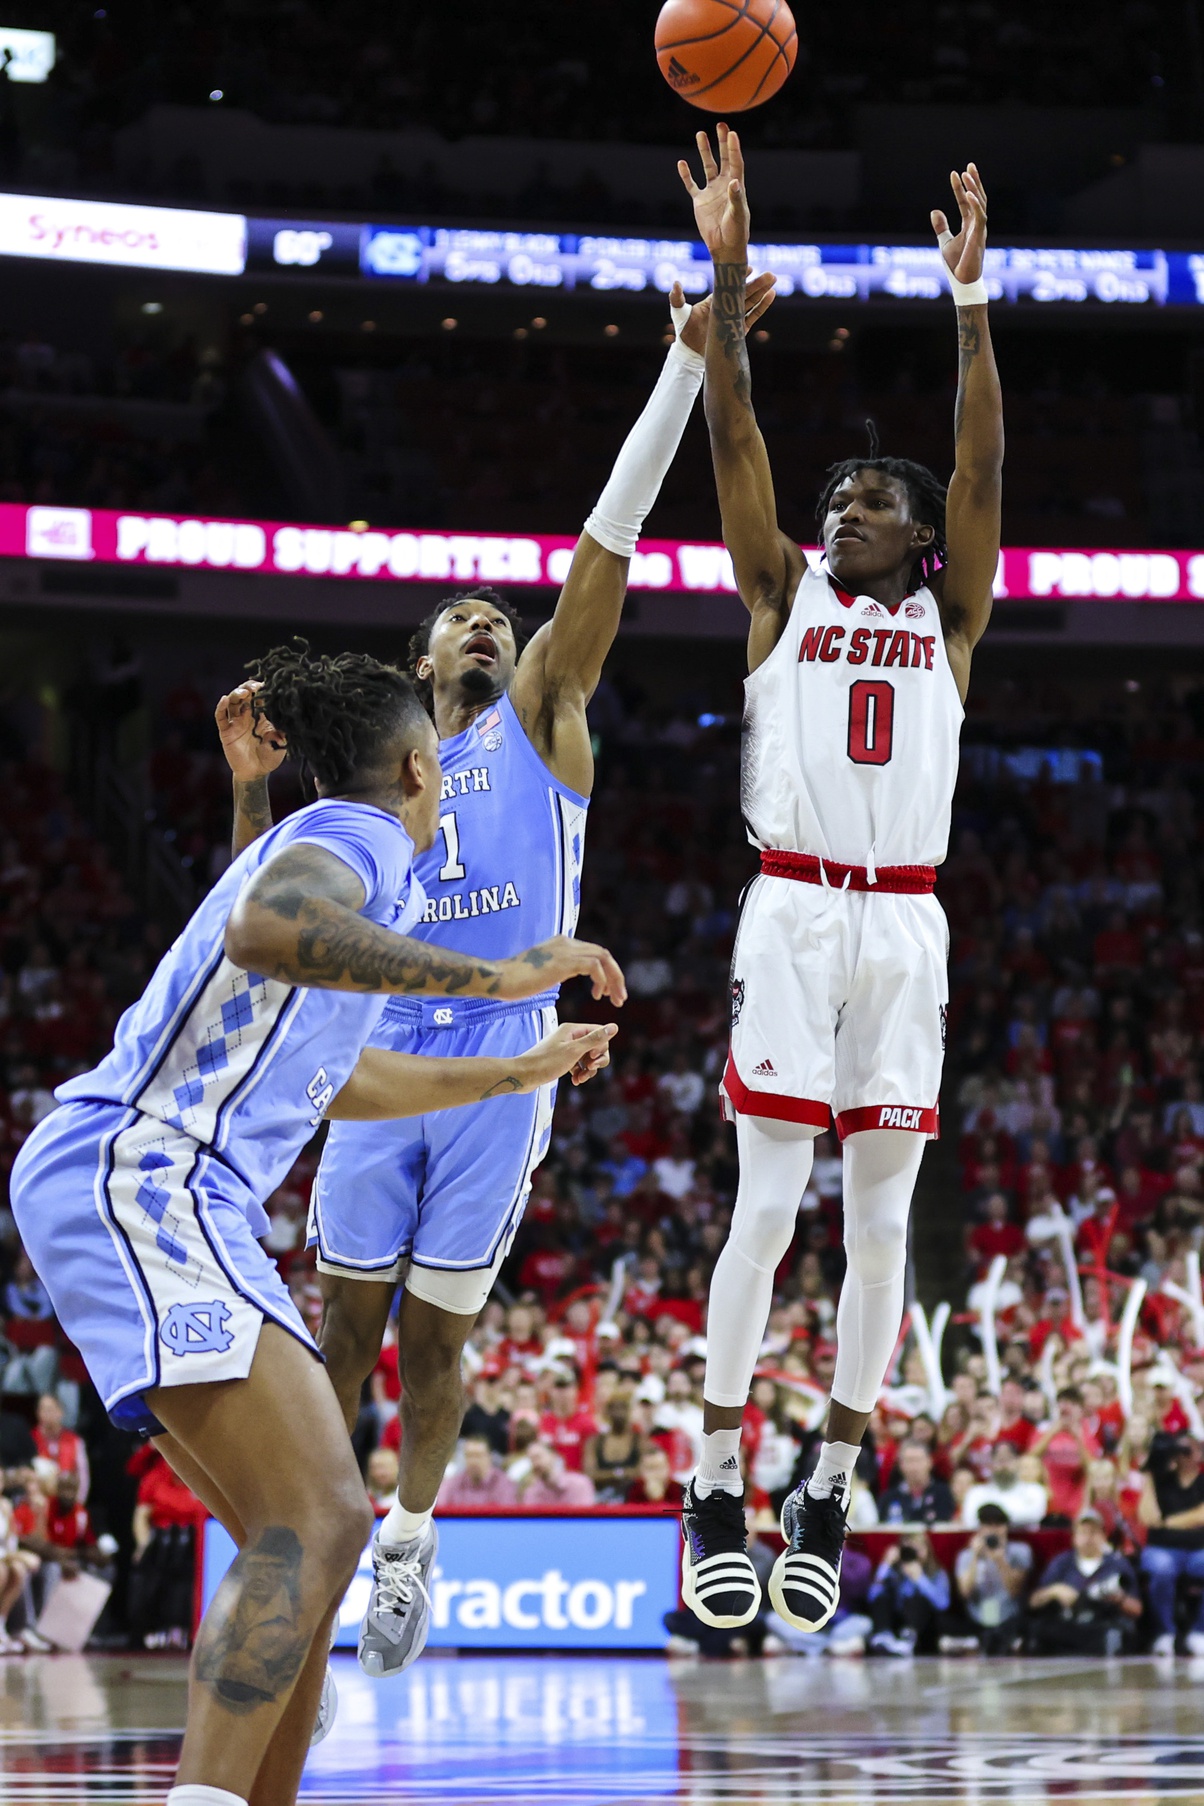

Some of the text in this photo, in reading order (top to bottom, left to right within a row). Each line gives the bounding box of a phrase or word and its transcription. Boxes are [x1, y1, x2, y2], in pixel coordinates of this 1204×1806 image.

[28, 213, 159, 250] Syneos
[116, 514, 266, 568] PROUD
[273, 526, 542, 584] SUPPORTER
[1027, 551, 1181, 599] PROUD
[798, 625, 936, 671] NC STATE
[847, 679, 895, 766] 0
[752, 1069, 778, 1077] adidas
[878, 1107, 923, 1130] PACK
